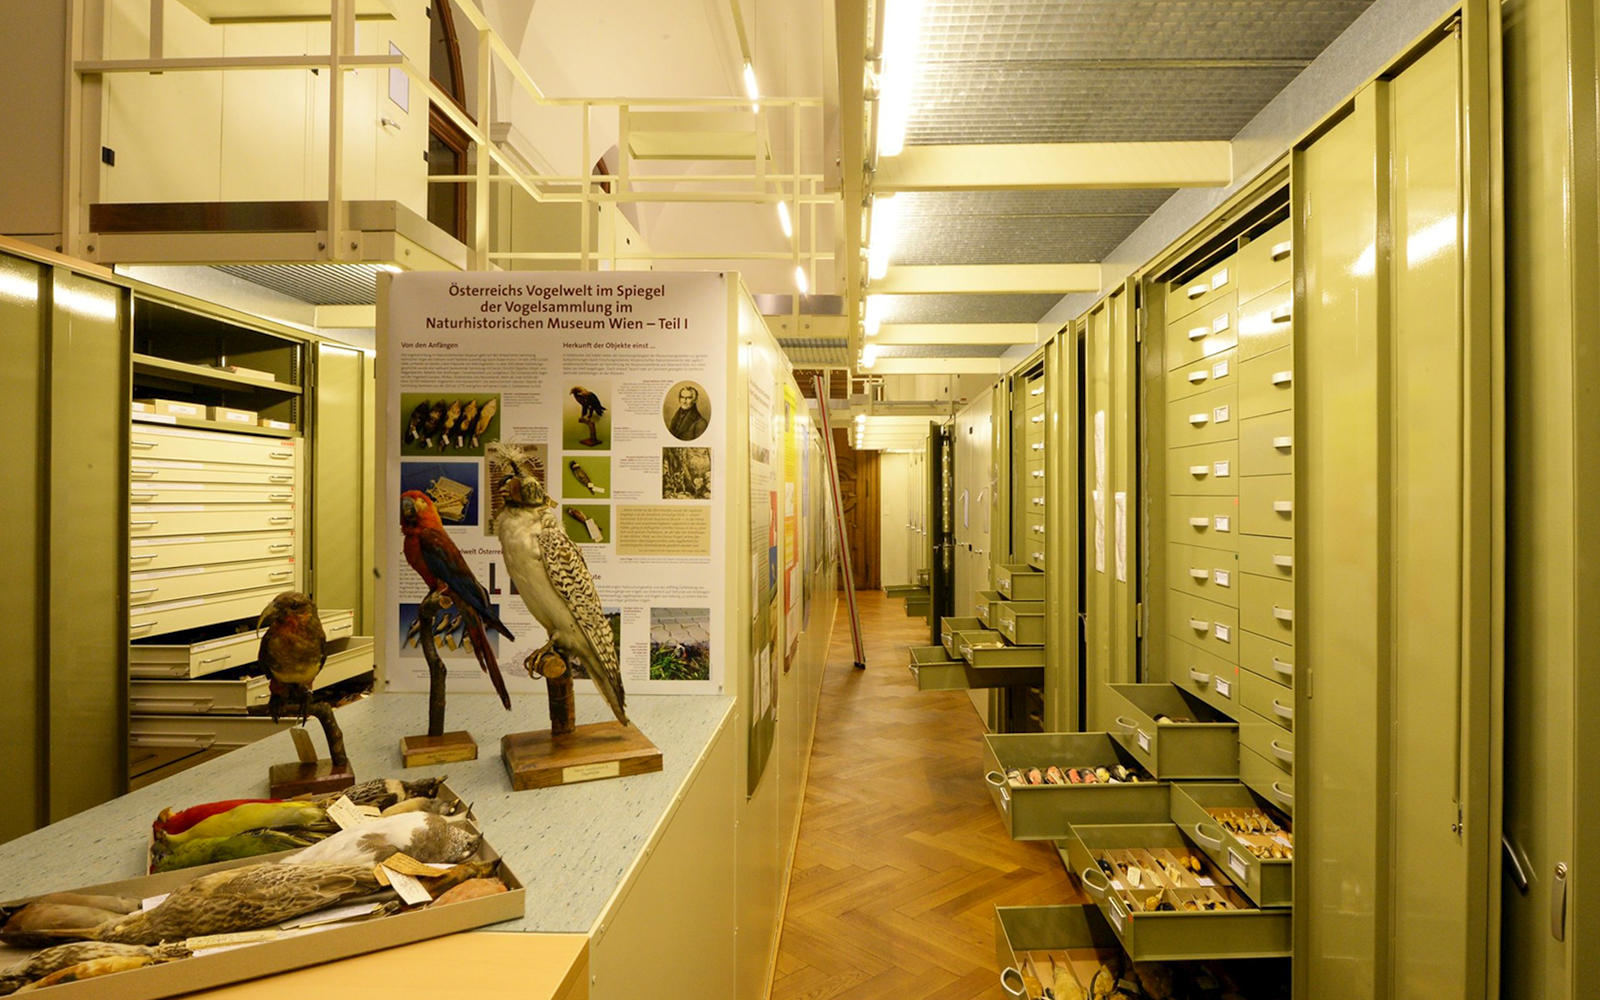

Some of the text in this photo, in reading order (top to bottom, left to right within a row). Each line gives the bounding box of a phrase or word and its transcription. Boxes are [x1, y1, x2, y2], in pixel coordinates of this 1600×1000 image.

[448, 282, 665, 301] Österreichs Vogelwelt im Spiegel
[480, 300, 633, 317] der Vogelsammlung im
[426, 317, 544, 329] Naturhistorischen
[547, 317, 605, 329] Museum
[608, 317, 643, 329] Wien
[658, 317, 681, 330] Teil
[684, 318, 688, 330] I
[428, 341, 459, 350] Anfängen
[562, 341, 592, 349] Herkunft
[593, 341, 604, 349] der
[605, 341, 631, 350] Objekte
[632, 341, 649, 349] einst
